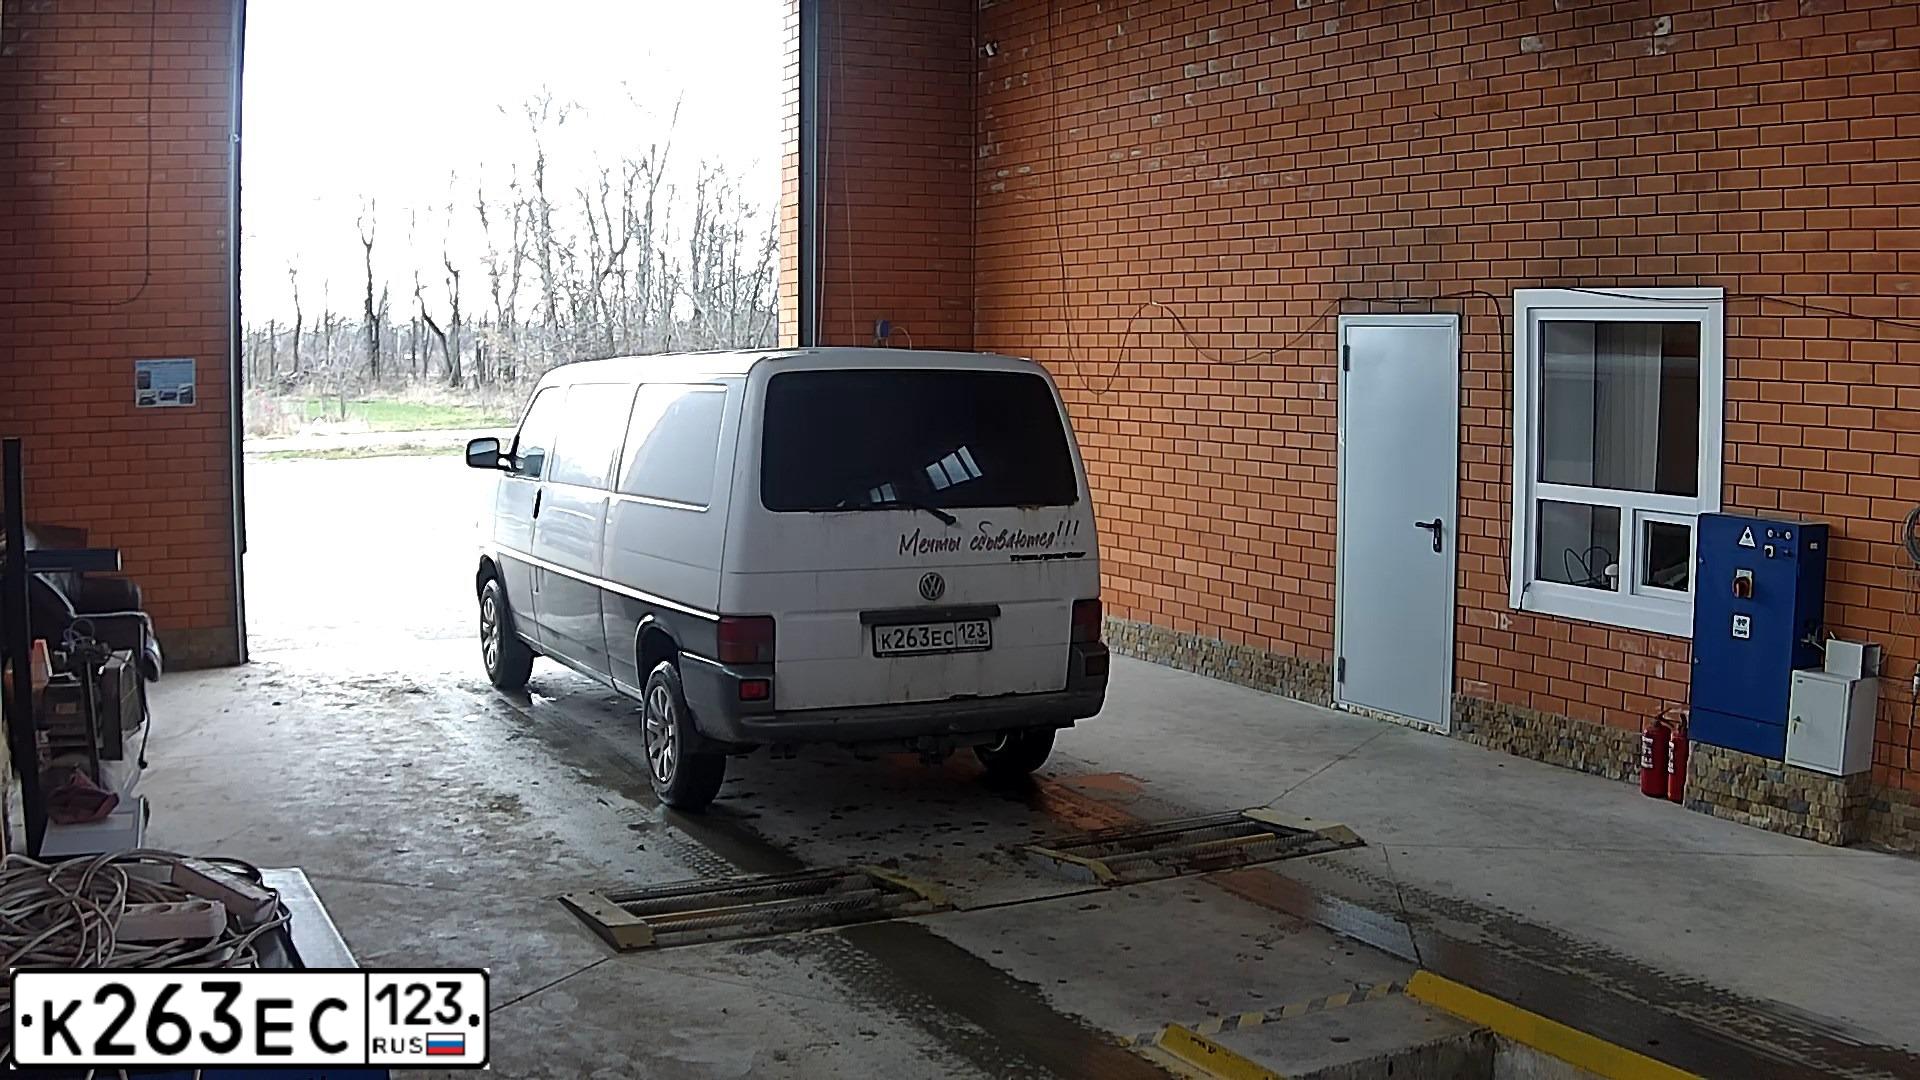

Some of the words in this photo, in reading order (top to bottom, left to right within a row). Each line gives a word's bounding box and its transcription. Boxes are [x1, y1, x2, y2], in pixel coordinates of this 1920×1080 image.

[899, 527, 961, 556] Мечты
[969, 520, 1079, 551] сбываются!!!
[959, 622, 985, 639] 123
